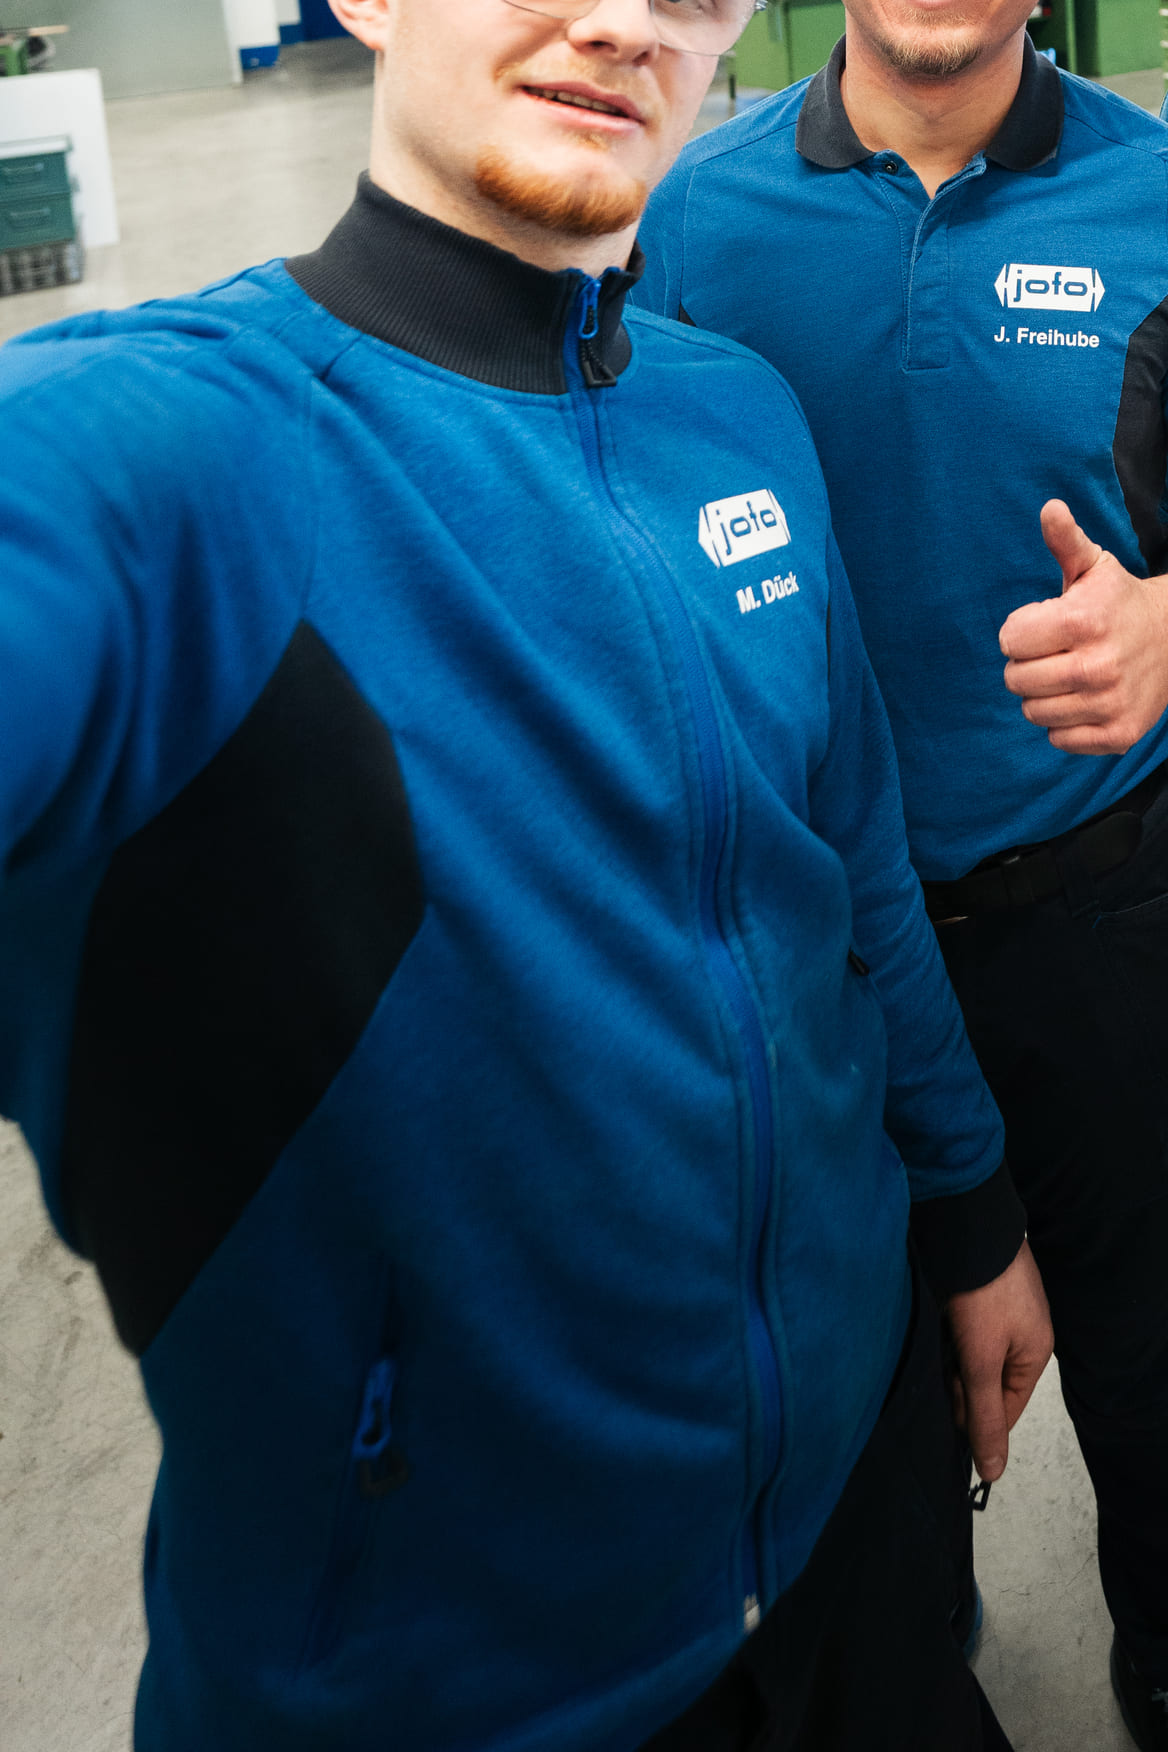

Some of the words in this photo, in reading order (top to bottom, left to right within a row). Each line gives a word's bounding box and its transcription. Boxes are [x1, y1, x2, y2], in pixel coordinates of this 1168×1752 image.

[1013, 269, 1088, 302] jofo
[993, 326, 1011, 343] J.
[1016, 327, 1100, 348] Freihube
[715, 500, 777, 556] jofo
[735, 585, 762, 614] M.
[761, 571, 800, 604] Dück
